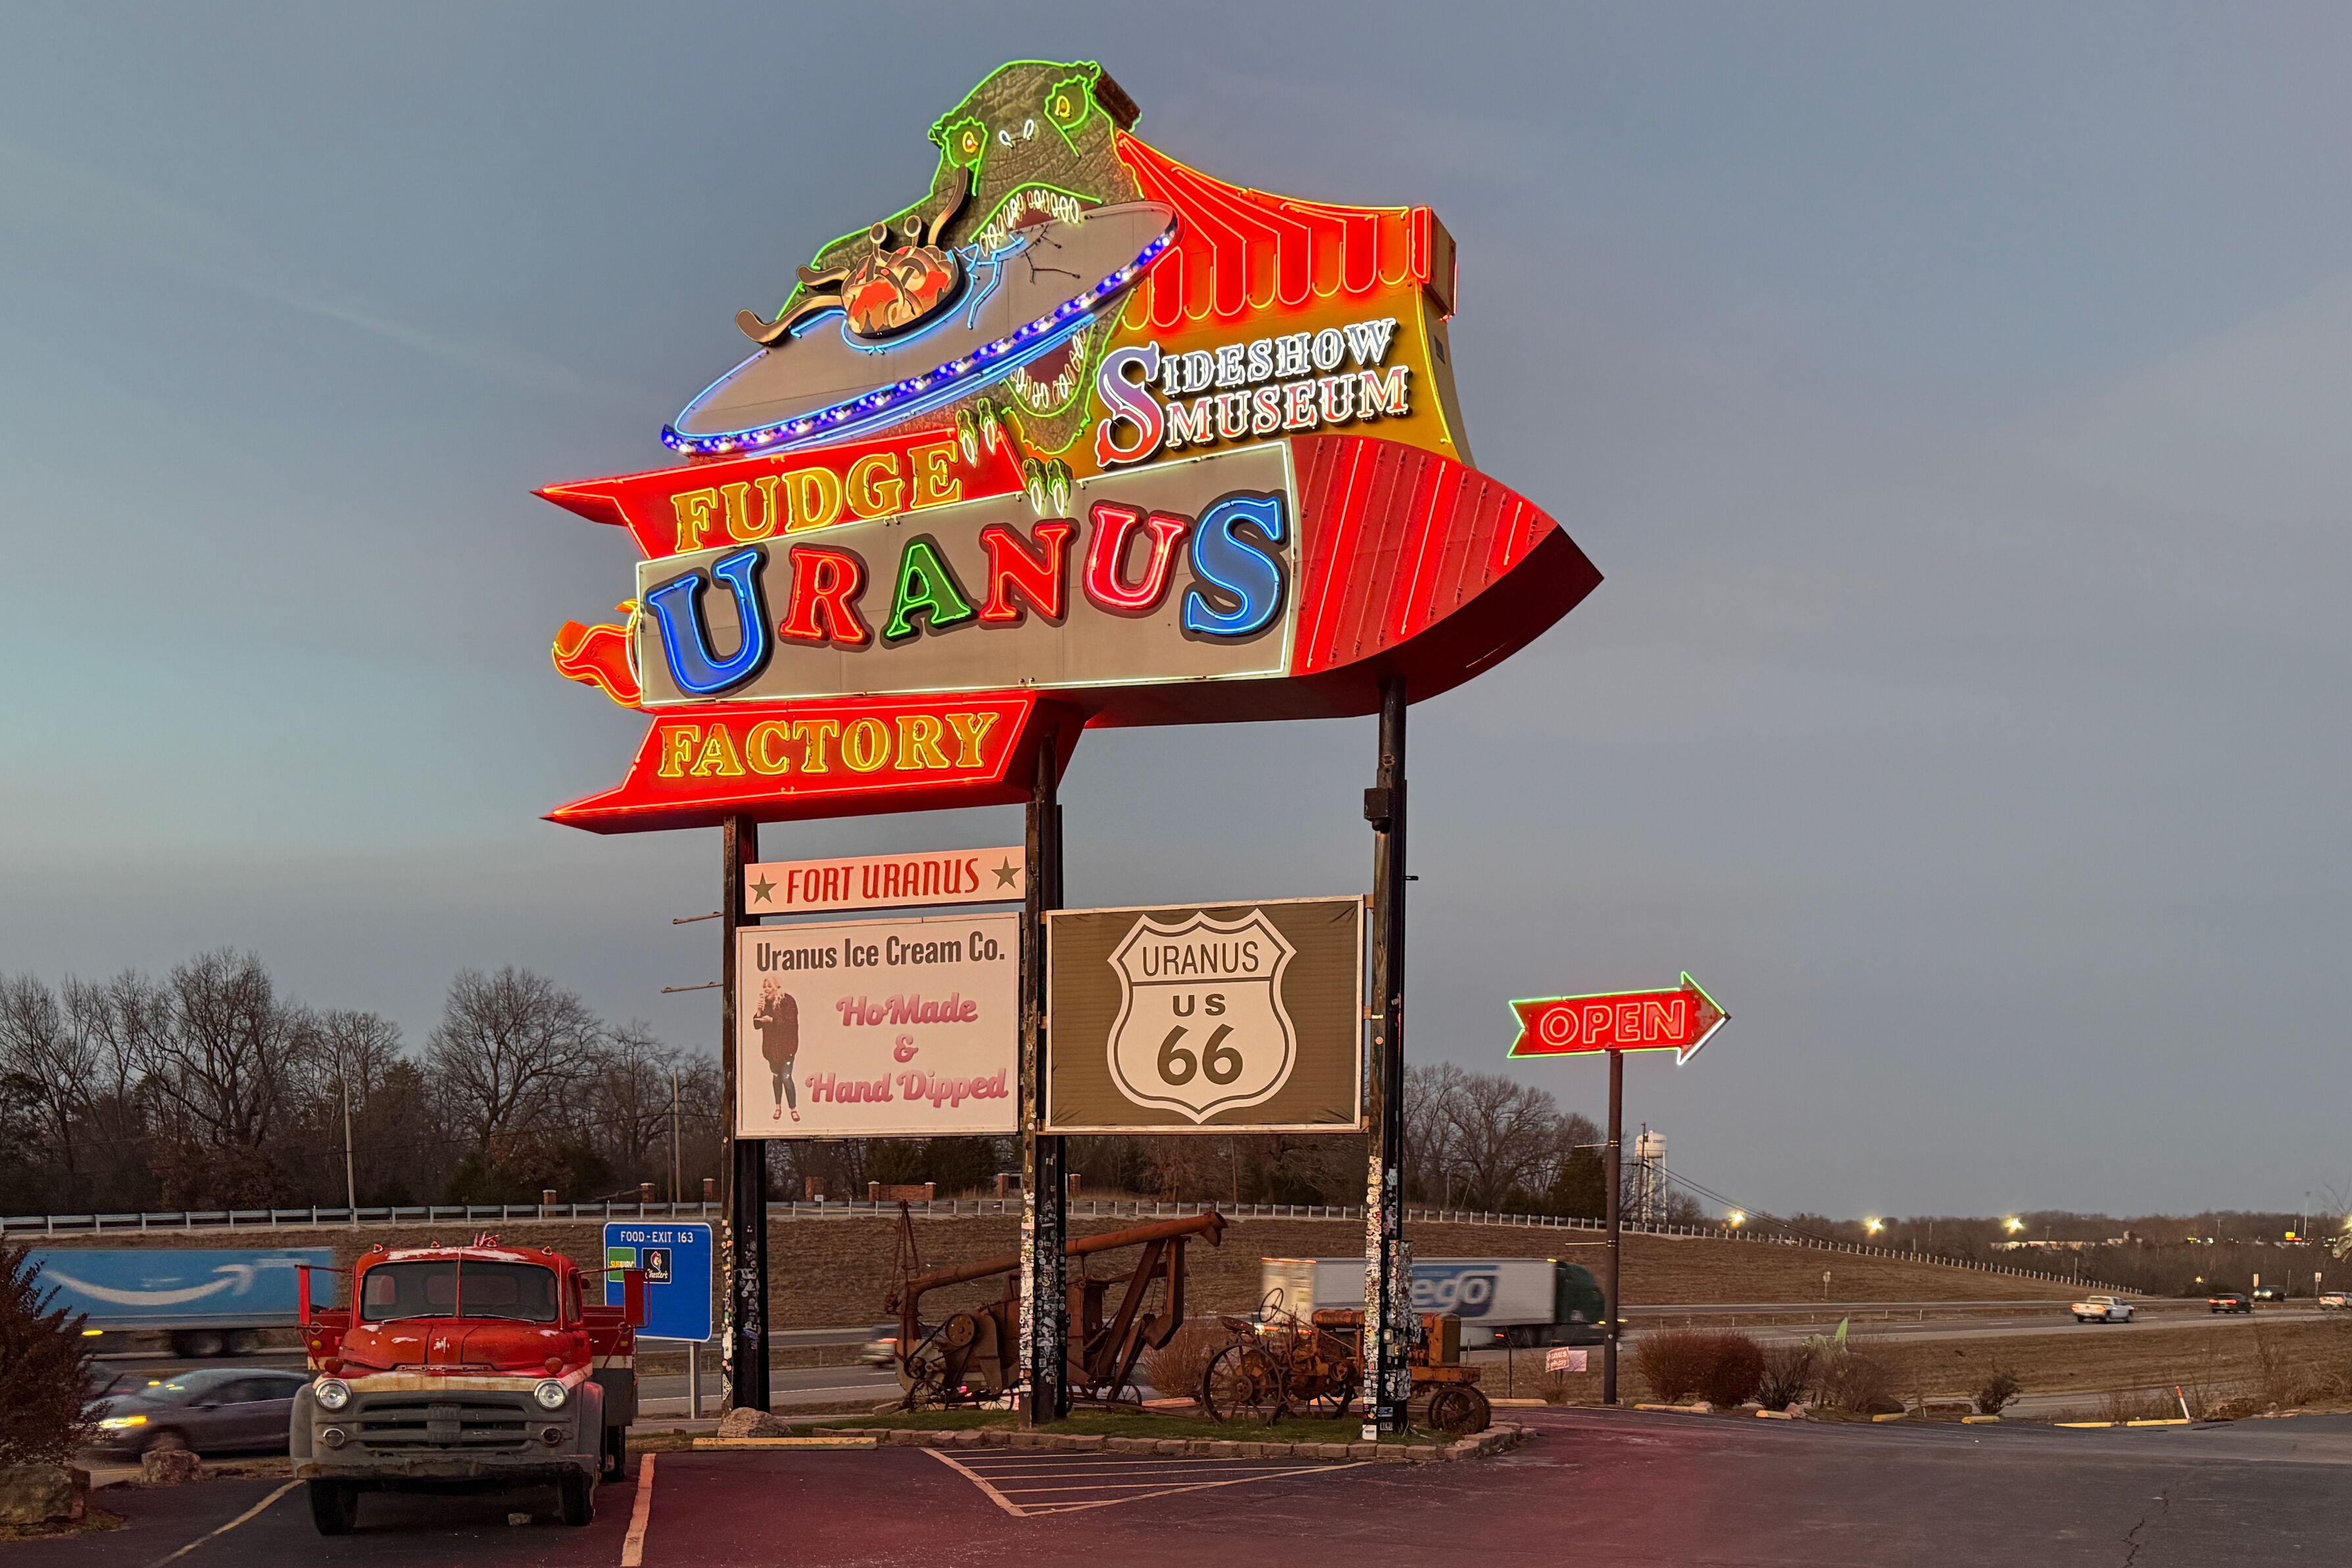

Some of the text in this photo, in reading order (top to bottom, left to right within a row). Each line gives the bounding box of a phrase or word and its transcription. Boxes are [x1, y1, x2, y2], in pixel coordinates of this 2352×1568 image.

[1095, 318, 1398, 468] SIDESHOW
[1165, 366, 1409, 449] MUSEUM
[670, 440, 962, 553] FUDGE
[646, 497, 1282, 695] URANUS
[658, 712, 1002, 777] FACTORY
[786, 858, 980, 904] FORT URANUS
[756, 931, 1005, 971] Uranus Ice Cream Co.
[1142, 941, 1260, 977] URANUS
[835, 992, 978, 1026] HoMade
[1540, 1000, 1685, 1046] OPEN
[893, 1033, 918, 1062] &
[1157, 1023, 1244, 1086] 66
[805, 1067, 1009, 1108] Hand Dipped
[620, 1231, 645, 1242] FOOD
[652, 1231, 673, 1242] EXIT
[677, 1232, 694, 1242] 163
